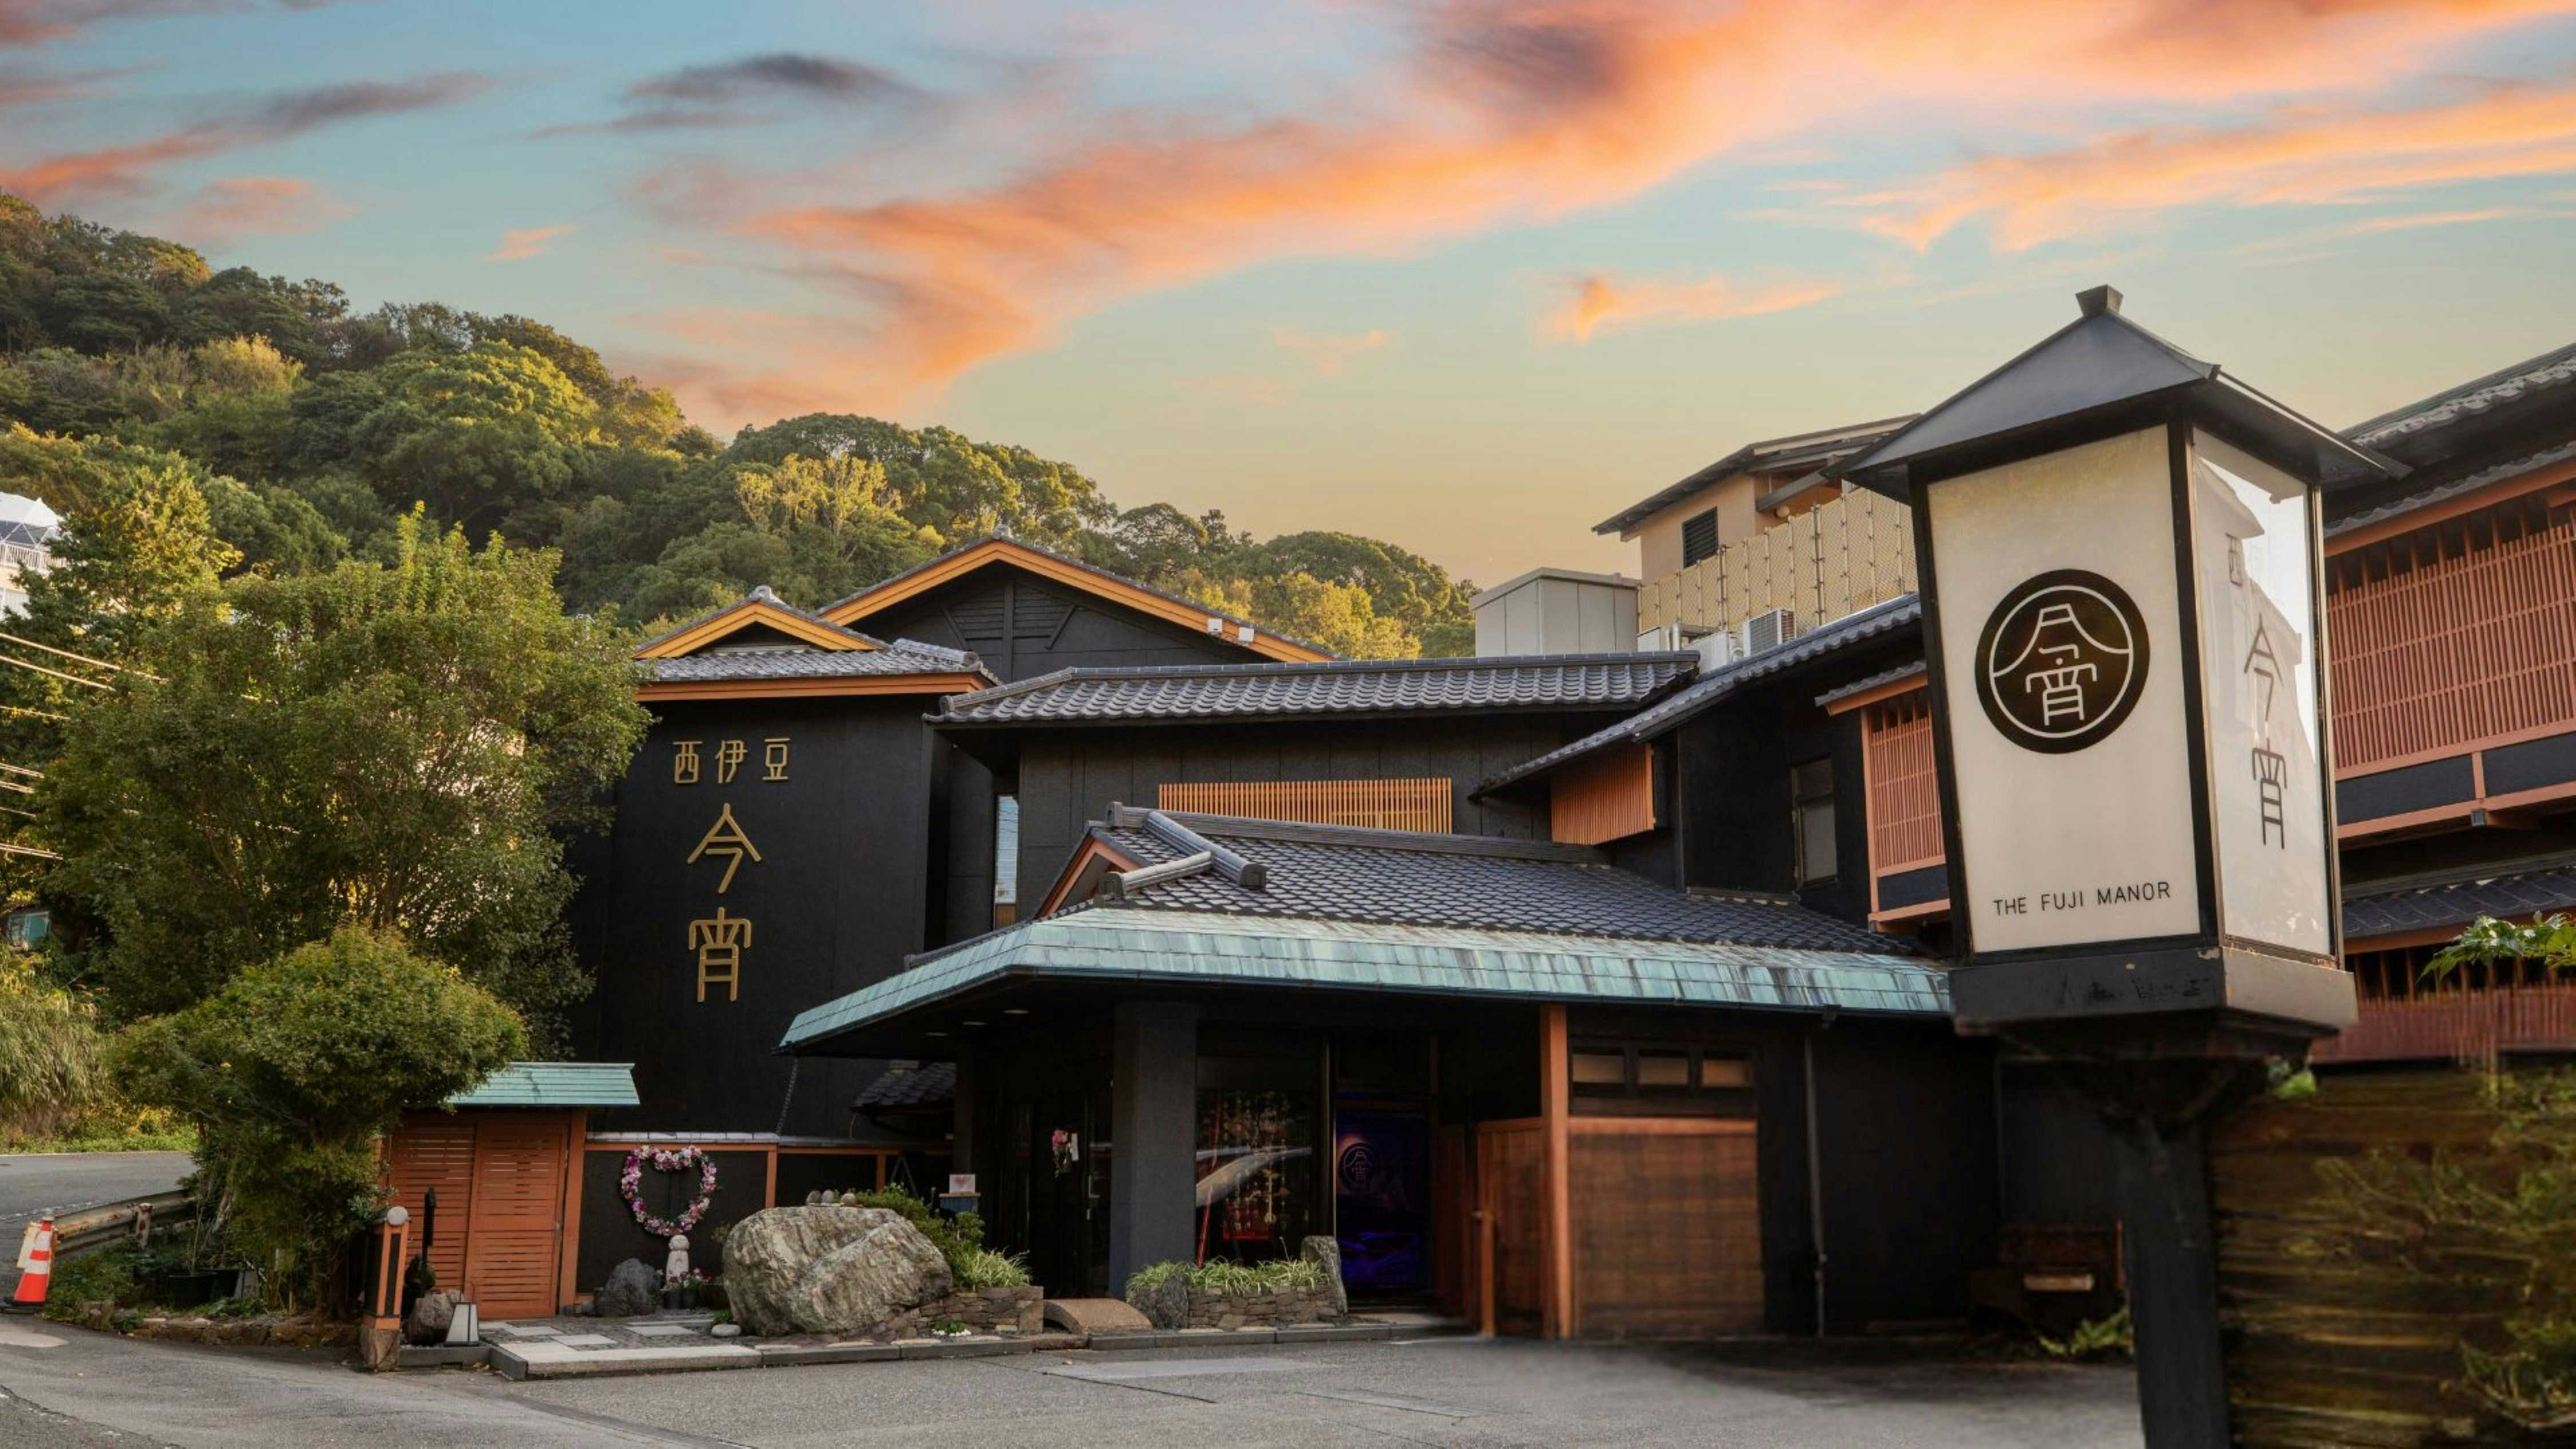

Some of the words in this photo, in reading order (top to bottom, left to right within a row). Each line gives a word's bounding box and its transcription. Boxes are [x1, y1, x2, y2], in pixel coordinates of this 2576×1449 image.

[673, 738, 791, 784] 西伊豆
[2245, 613, 2287, 850] 今宵
[687, 803, 762, 1002] 今宵
[1993, 897, 2028, 916] THE
[2041, 890, 2084, 911] FUJI
[2097, 882, 2171, 906] MANOR
